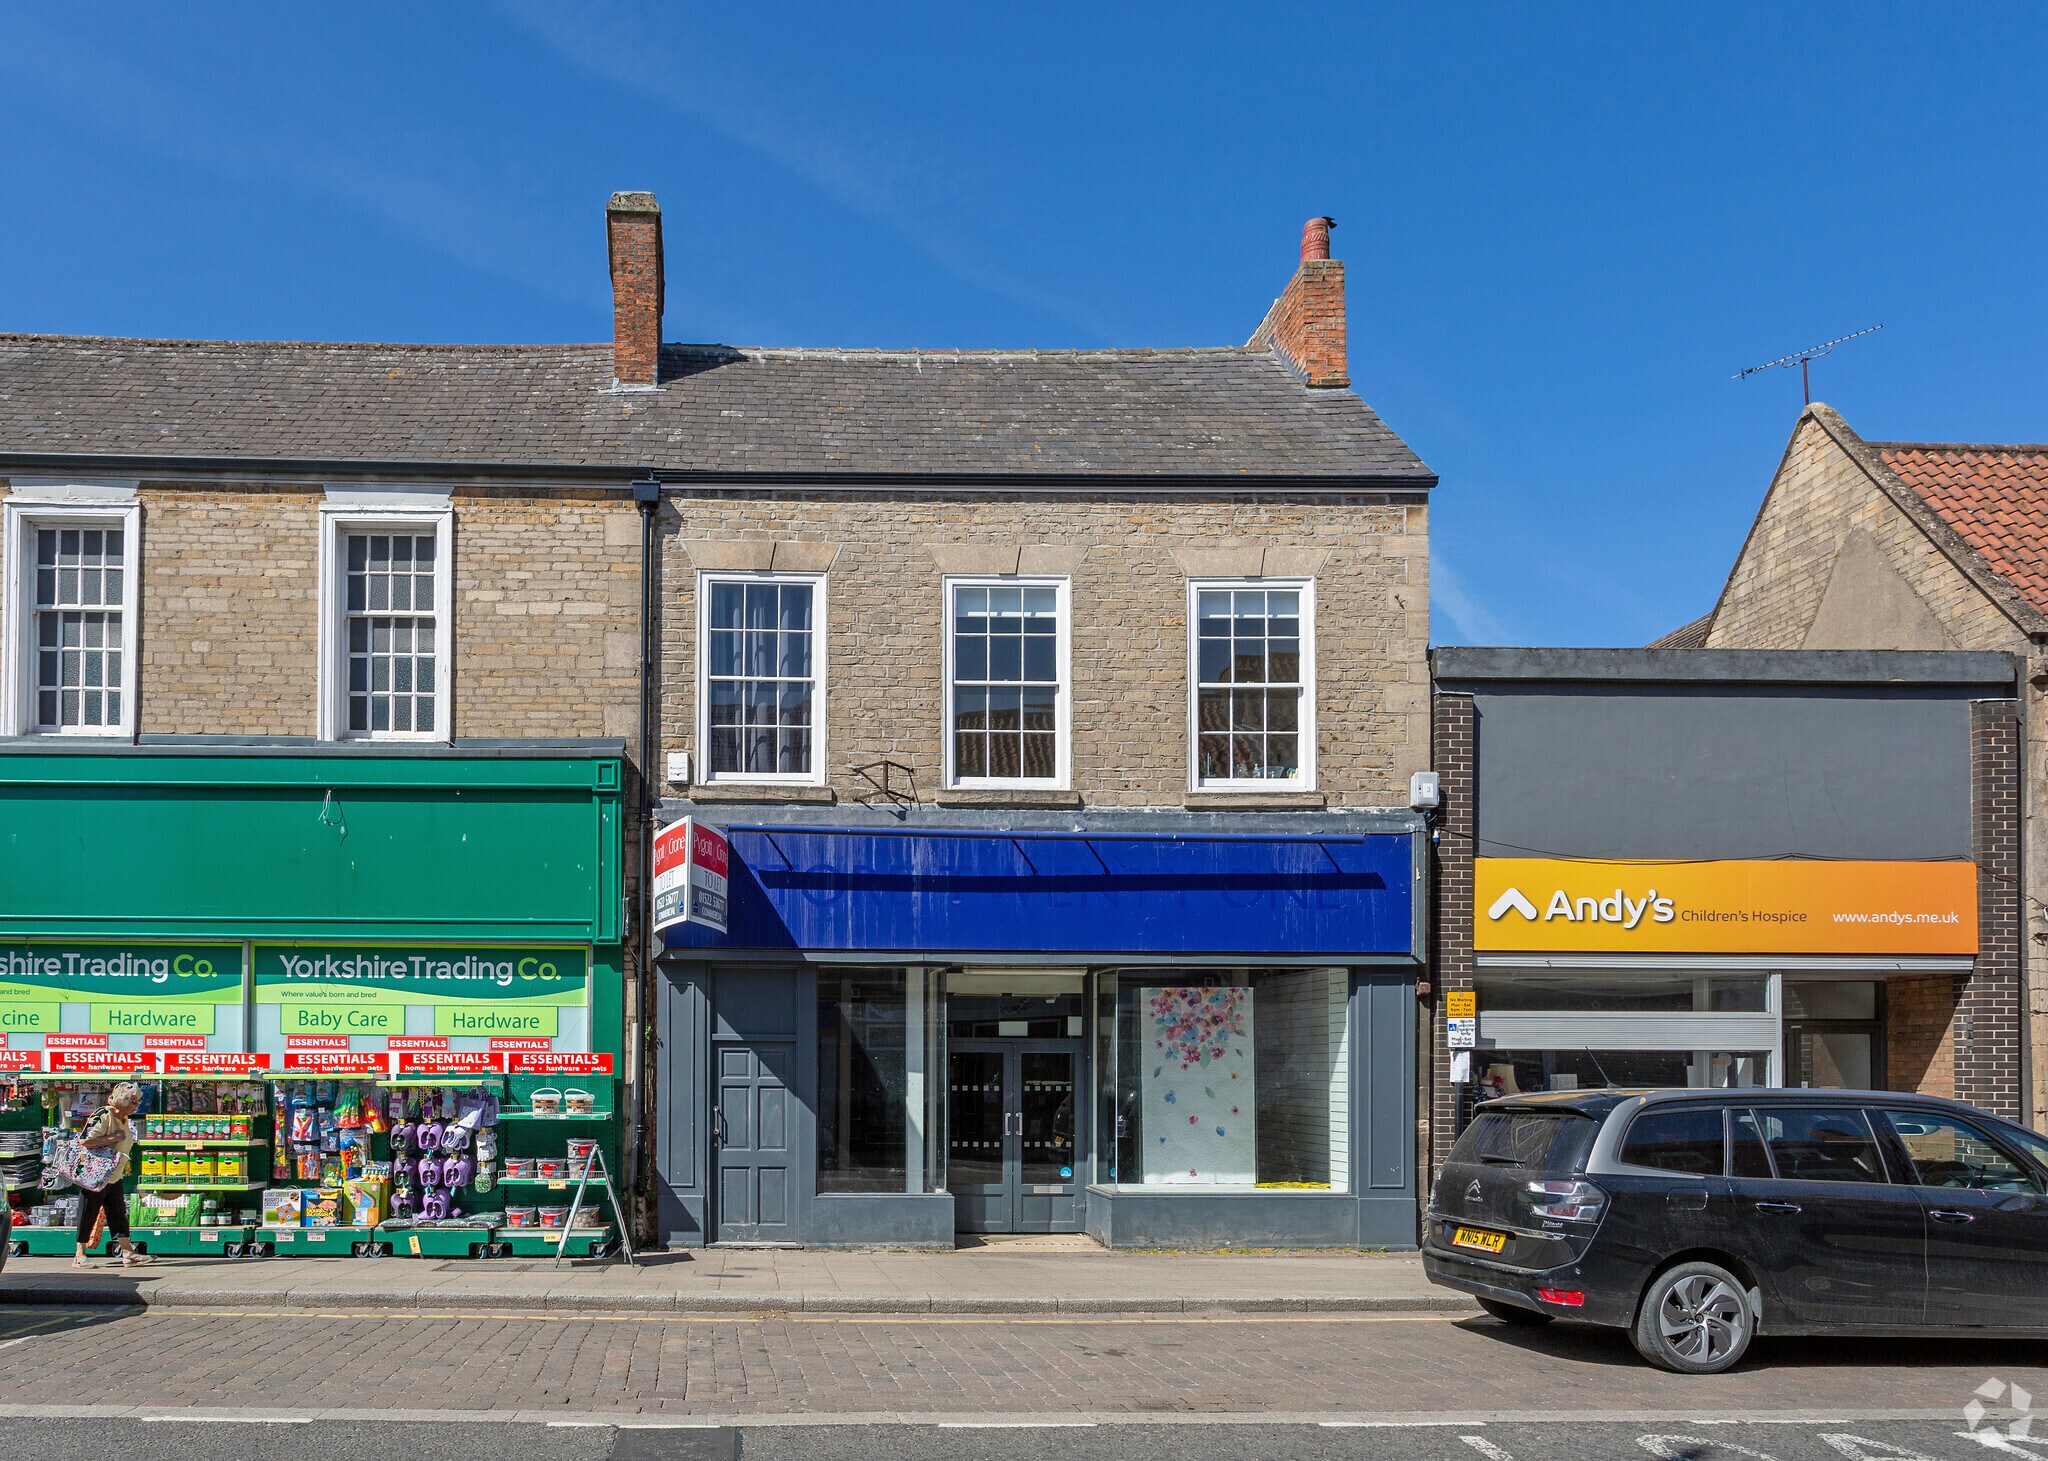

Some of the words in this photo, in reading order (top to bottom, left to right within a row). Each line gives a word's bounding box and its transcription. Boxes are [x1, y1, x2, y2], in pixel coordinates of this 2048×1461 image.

[668, 835, 686, 855] Crone
[693, 831, 713, 857] Pygott
[704, 871, 713, 889] TO
[713, 874, 722, 892] LET
[1544, 888, 1675, 929] Andy's
[1681, 909, 1749, 922] Children's
[1752, 910, 1807, 925] Hospice
[1832, 911, 1960, 925] www.andys.me.uk
[173, 954, 218, 978] Co.
[518, 957, 562, 981] Co.
[109, 1010, 197, 1027] Hardware
[298, 1010, 342, 1031] Baby
[347, 1010, 388, 1027] Care
[453, 1012, 540, 1029] Hardware
[48, 1038, 106, 1046] ESSENTIALS
[146, 1038, 204, 1047] ESSENTIALS
[289, 1038, 347, 1046] ESSENTIALS
[389, 1040, 447, 1048] ESSENTIALS
[492, 1040, 549, 1048] ESSENTIALS
[64, 1053, 142, 1063] ESSENTIALS
[178, 1054, 256, 1064] ESSENTIALS
[298, 1054, 375, 1064] ESSENTIALS
[413, 1053, 490, 1064] ESSENTIALS
[522, 1054, 599, 1065] ESSENTIALS
[56, 1063, 77, 1071] home
[88, 1063, 123, 1071] hardware
[170, 1064, 191, 1072] home
[202, 1064, 237, 1072] hardware
[1460, 1228, 1479, 1244] WN15
[1480, 1232, 1500, 1248] WLR
